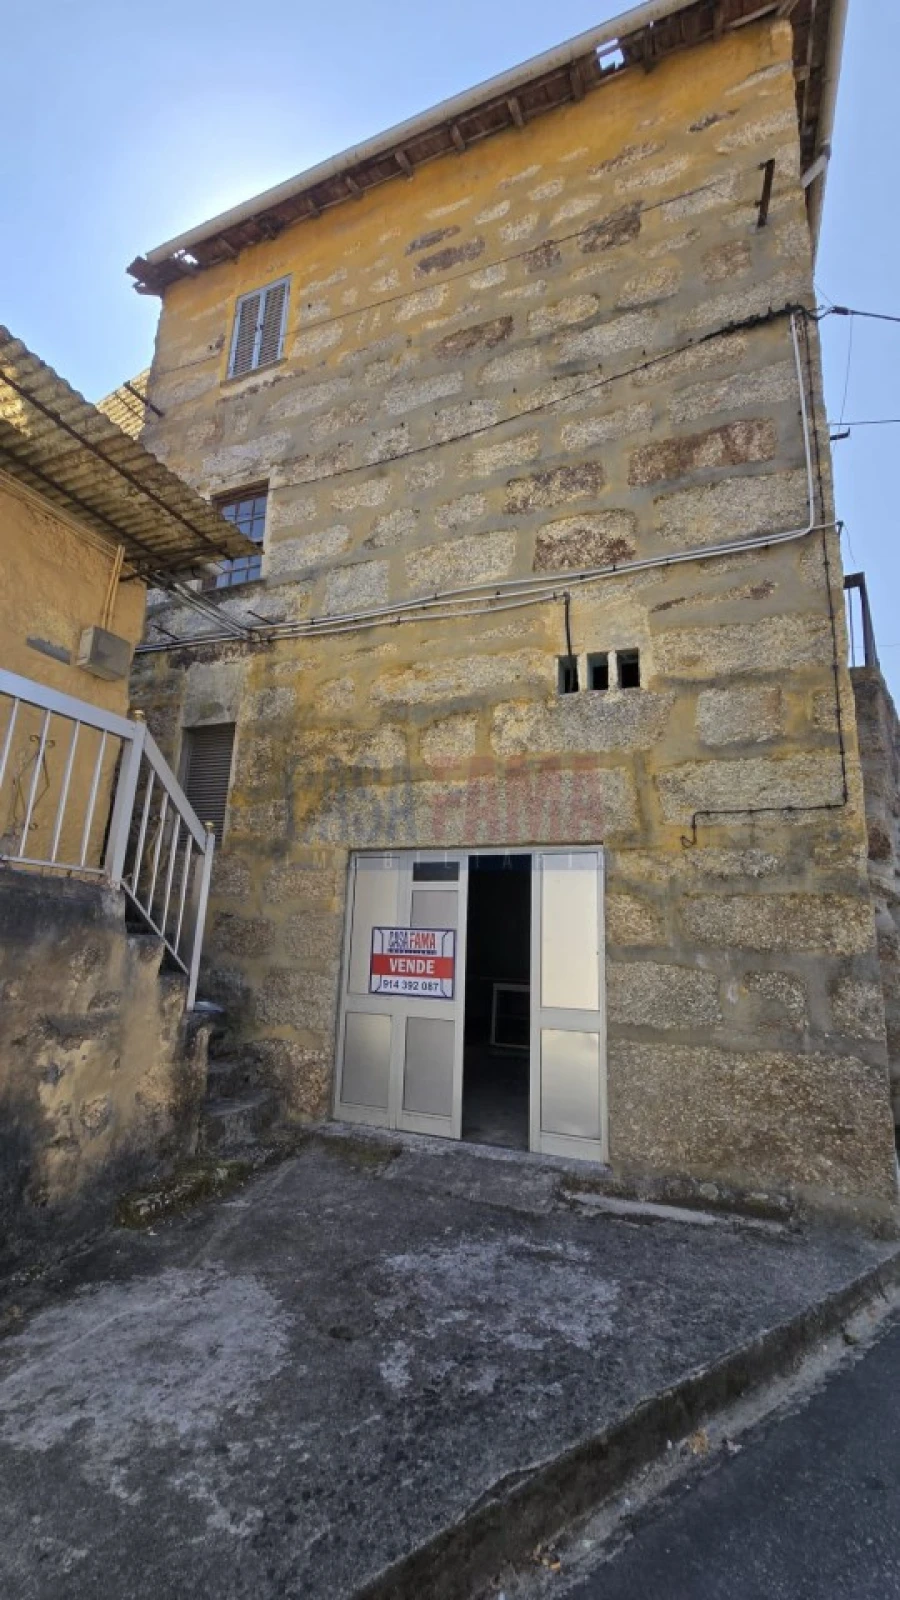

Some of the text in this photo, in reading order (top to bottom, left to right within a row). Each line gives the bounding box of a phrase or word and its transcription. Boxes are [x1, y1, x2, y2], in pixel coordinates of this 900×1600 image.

[409, 932, 436, 949] FAMA
[389, 957, 435, 974] VENDE
[382, 979, 439, 991] 914 392 087
